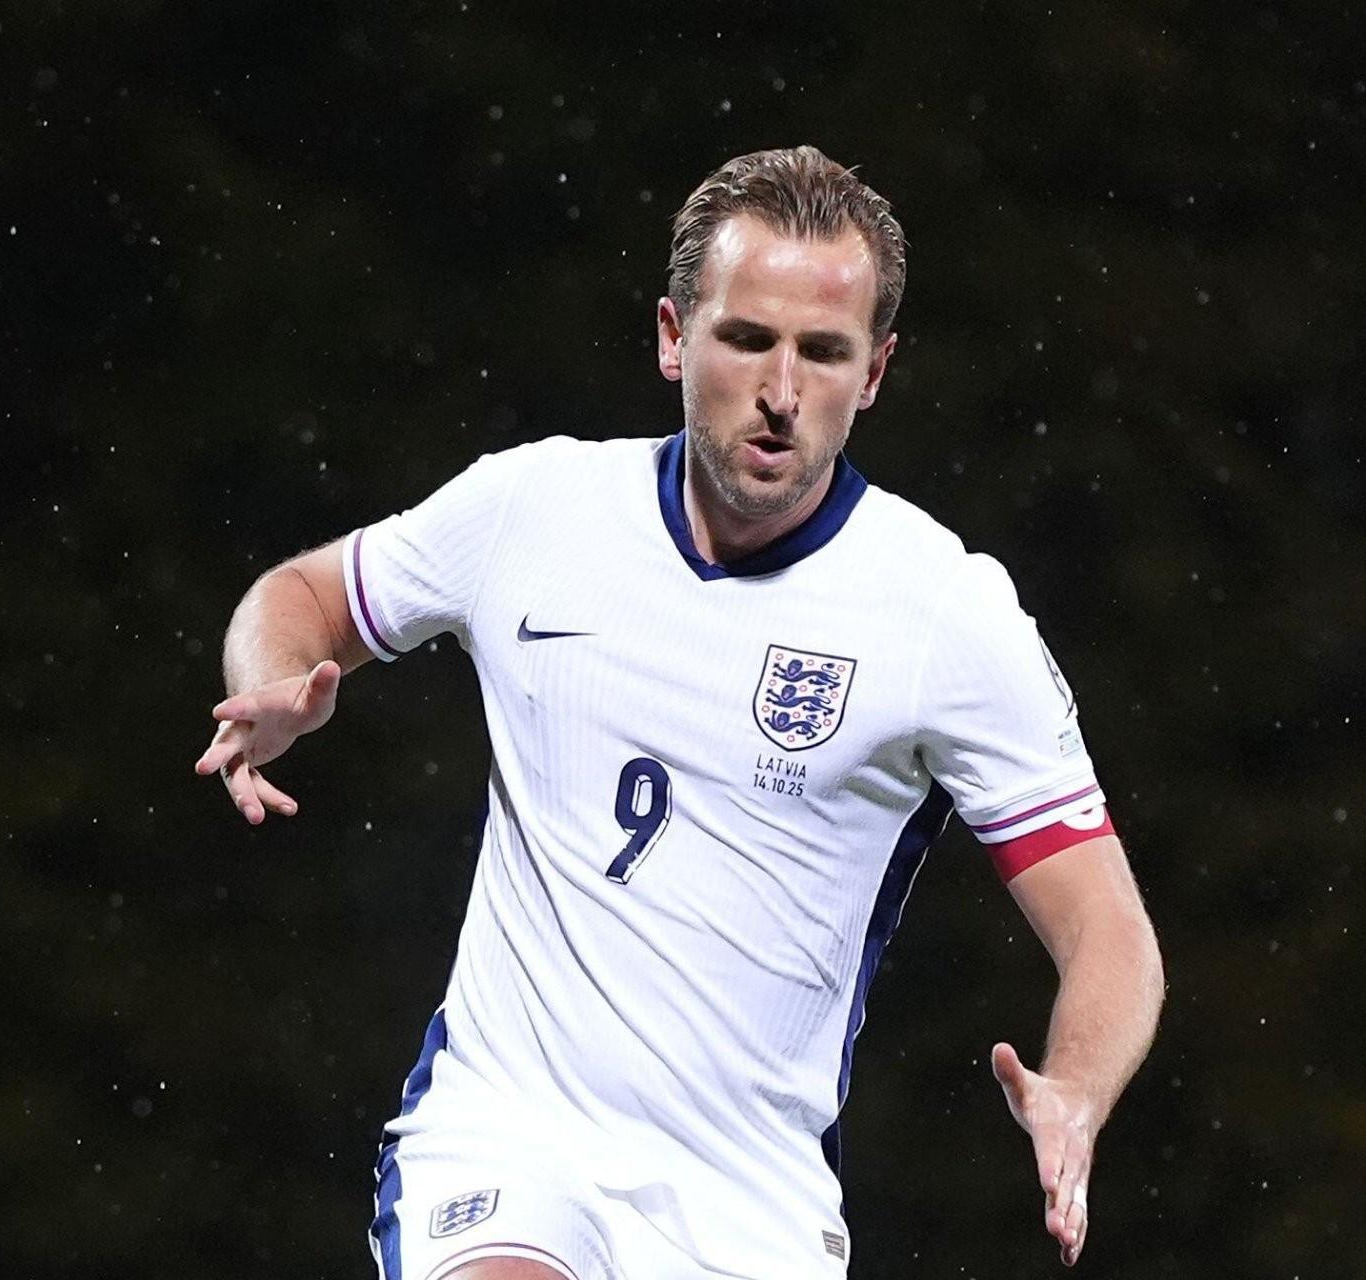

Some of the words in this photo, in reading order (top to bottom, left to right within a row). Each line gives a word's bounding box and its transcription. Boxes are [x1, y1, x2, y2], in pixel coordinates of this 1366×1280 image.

[756, 753, 806, 778] LATVIA
[754, 773, 804, 797] 14.10.25
[606, 757, 672, 885] 9
